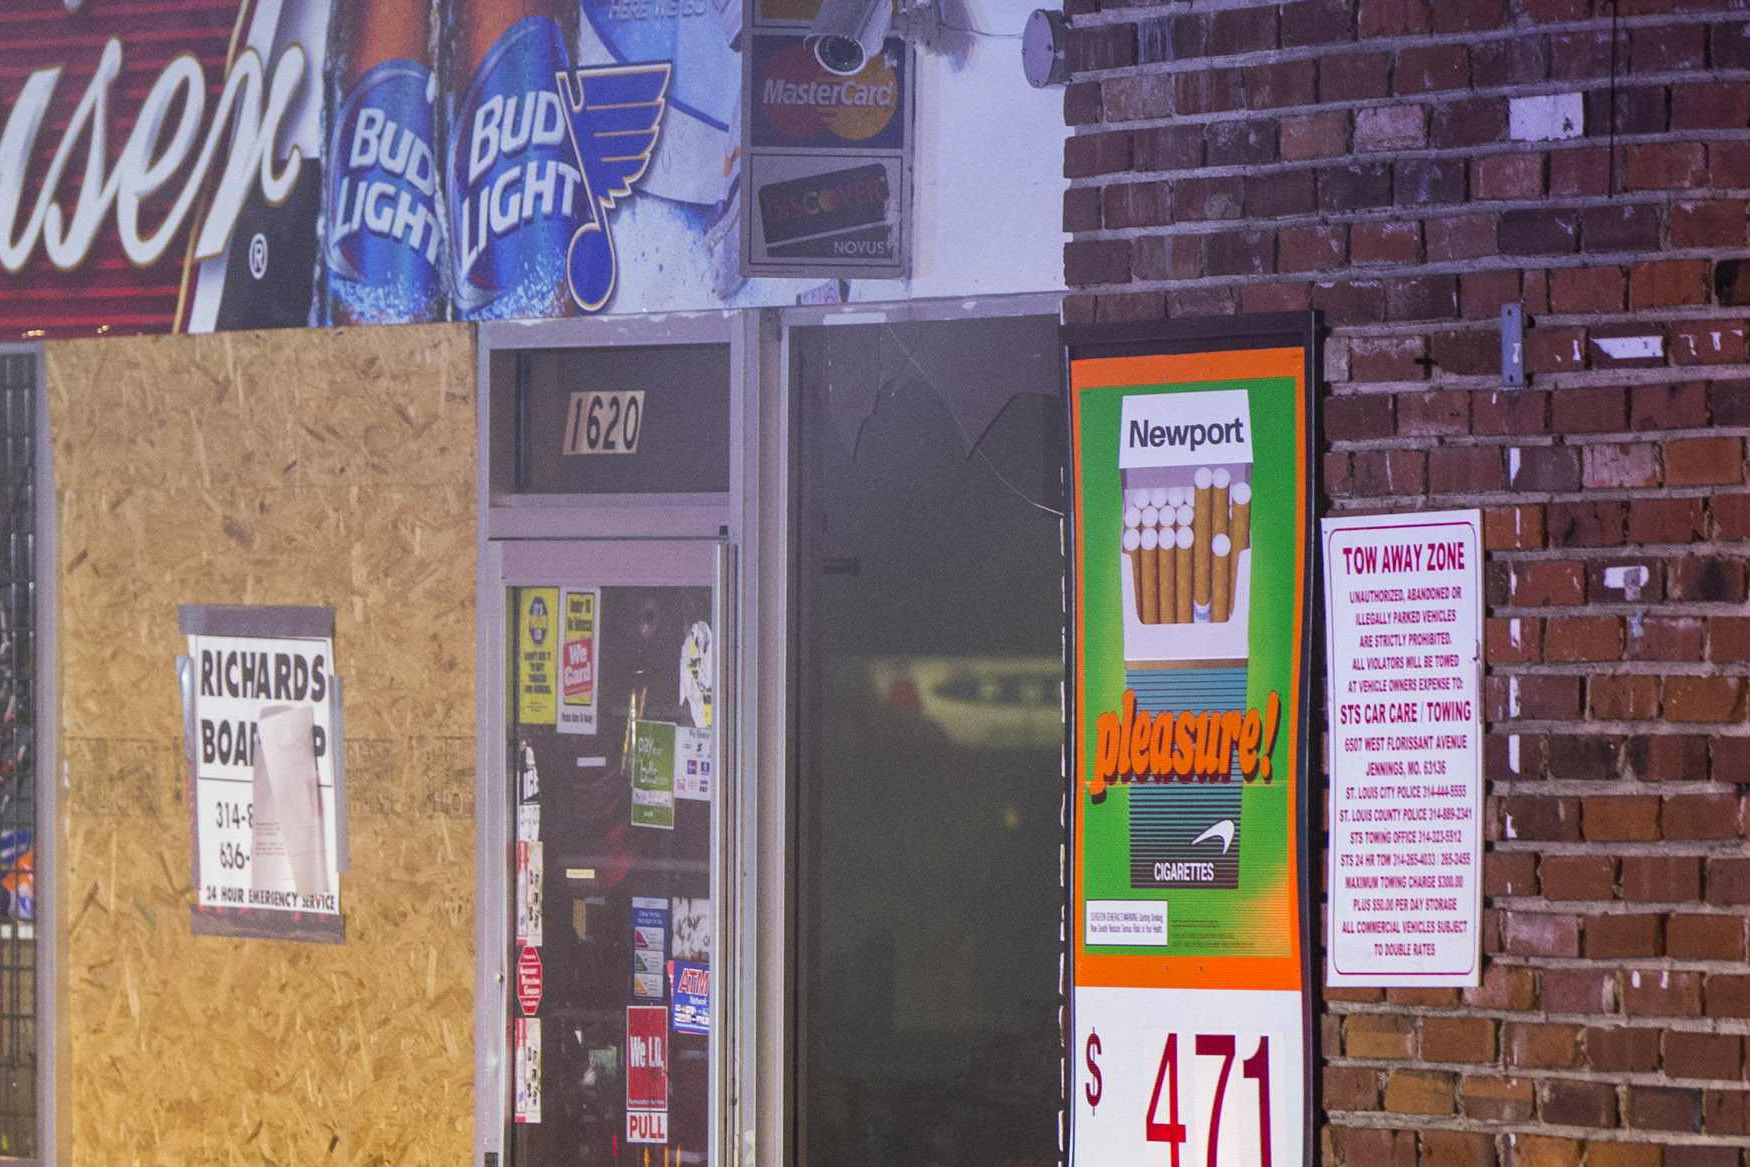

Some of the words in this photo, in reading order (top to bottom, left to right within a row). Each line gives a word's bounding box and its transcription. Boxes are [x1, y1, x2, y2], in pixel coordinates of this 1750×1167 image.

[763, 80, 895, 107] MasterCard
[468, 89, 566, 166] BUD
[350, 107, 438, 193] BUD
[332, 176, 445, 264] LIGHT
[459, 159, 582, 268] LIGHT
[834, 239, 884, 256] NOVUS
[570, 396, 640, 453] 1620
[1129, 417, 1245, 452] Newport
[1343, 546, 1377, 575] TOW
[1382, 543, 1422, 573] AWAY
[1427, 541, 1465, 571] ZONE
[1407, 587, 1449, 601] ABANDONED
[1451, 586, 1462, 599] OR
[1356, 611, 1392, 626] ILLEGALLY
[1393, 610, 1420, 624] PARKED
[1423, 609, 1456, 623] VEHICLES
[1360, 634, 1373, 648] ARE
[1375, 634, 1407, 647] STRICTLY
[1353, 657, 1364, 671] ALL
[1367, 656, 1404, 670] VIOLATORS
[1406, 655, 1422, 668] WILL
[1424, 655, 1433, 668] BE
[1435, 654, 1459, 667] TOWED
[201, 649, 326, 702] RICHARDS
[1348, 680, 1357, 692] AT
[1359, 679, 1387, 692] VEHICLE
[1389, 678, 1417, 691] OWNERS
[1419, 677, 1450, 691] EXPENSE
[1340, 704, 1361, 725] STS
[1365, 703, 1386, 724] CAR
[1389, 702, 1417, 723] CARE
[1427, 700, 1471, 721] TOWING
[200, 719, 258, 767] BOA
[1089, 688, 1281, 805] pleasure!
[1364, 736, 1385, 751] WEST
[1387, 735, 1434, 751] FLORISSANT
[1436, 734, 1467, 749] AVENUE
[1358, 786, 1378, 799] LOUIS
[1380, 786, 1395, 799] CITY
[1397, 785, 1421, 799] POLICE
[1352, 809, 1372, 822] LOUIS
[1374, 808, 1401, 822] COUNTY
[1403, 808, 1427, 821] POLICE
[1350, 832, 1363, 844] STS
[1365, 831, 1391, 844] TOWING
[1393, 831, 1416, 844] OFFICE
[1340, 855, 1354, 867] STS
[1355, 854, 1364, 866] 24
[1365, 854, 1375, 866] HR
[1377, 854, 1391, 866] TOW
[1154, 863, 1215, 882] CIGARETTES
[1345, 876, 1379, 889] MAXIMUM
[1380, 876, 1407, 889] TOWING
[1409, 875, 1436, 888] CHARGE
[221, 886, 244, 904] HOUR
[249, 888, 299, 909] EMERGENCY
[1353, 898, 1371, 912] PLUS
[1396, 898, 1408, 911] PER
[1410, 898, 1424, 911] DAY
[1425, 897, 1457, 911] STORAGE
[1342, 921, 1355, 933] ALL
[1356, 921, 1400, 934] COMMERCIAL
[1402, 921, 1435, 933] VEHICLES
[1437, 920, 1468, 933] SUBJECT
[1374, 944, 1383, 956] TO
[1385, 943, 1411, 956] DOUBLE
[1413, 943, 1436, 956] RATES
[630, 1035, 646, 1068] We
[1085, 1026, 1102, 1117] $
[630, 1115, 665, 1139] PULL
